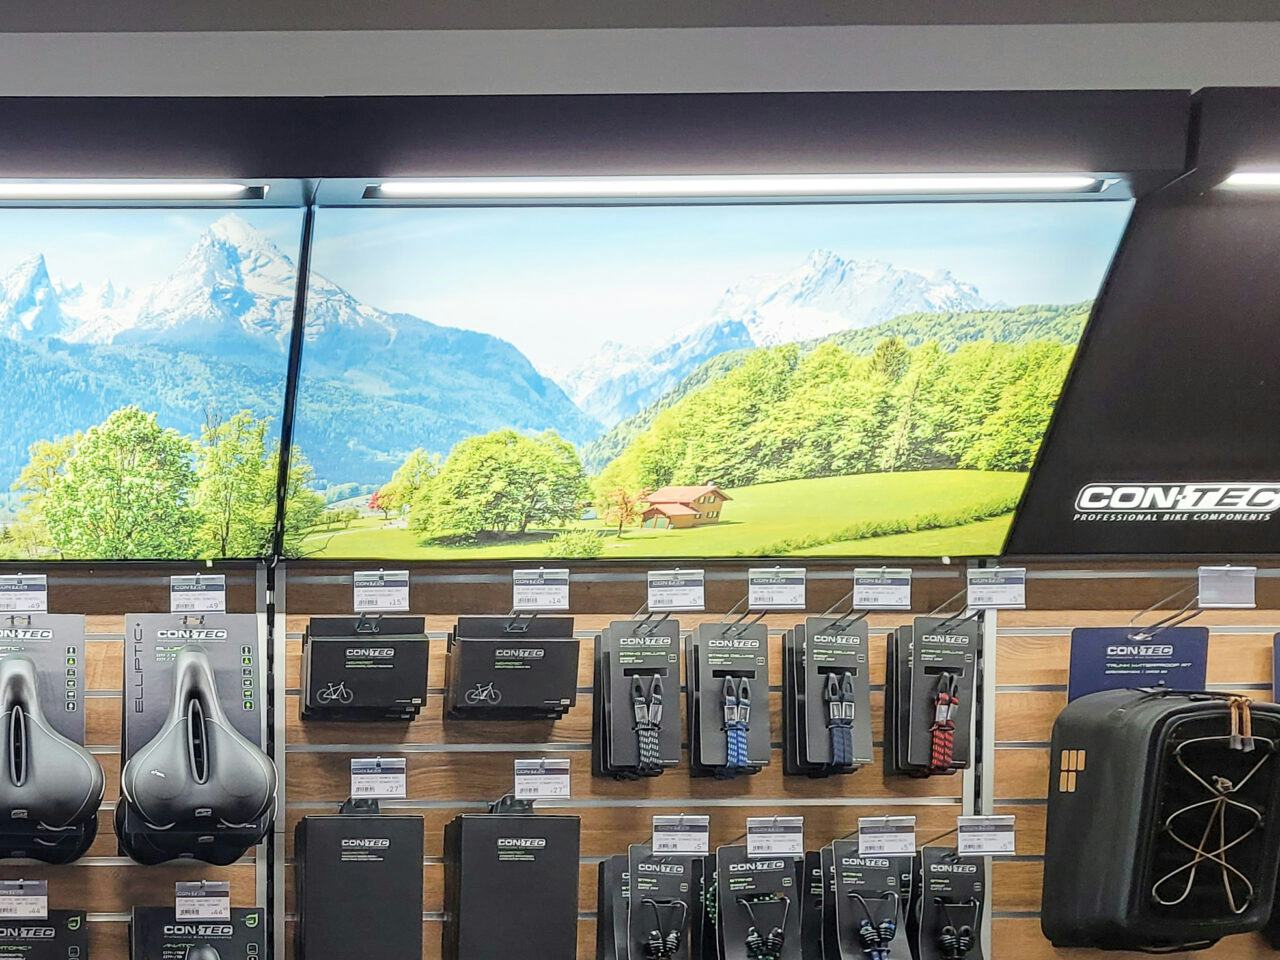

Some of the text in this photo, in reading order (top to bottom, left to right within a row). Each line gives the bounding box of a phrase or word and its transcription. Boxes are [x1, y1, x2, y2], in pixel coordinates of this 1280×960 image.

[1073, 513, 1272, 521] PROFESSIONAL BIKE COMPONENTS
